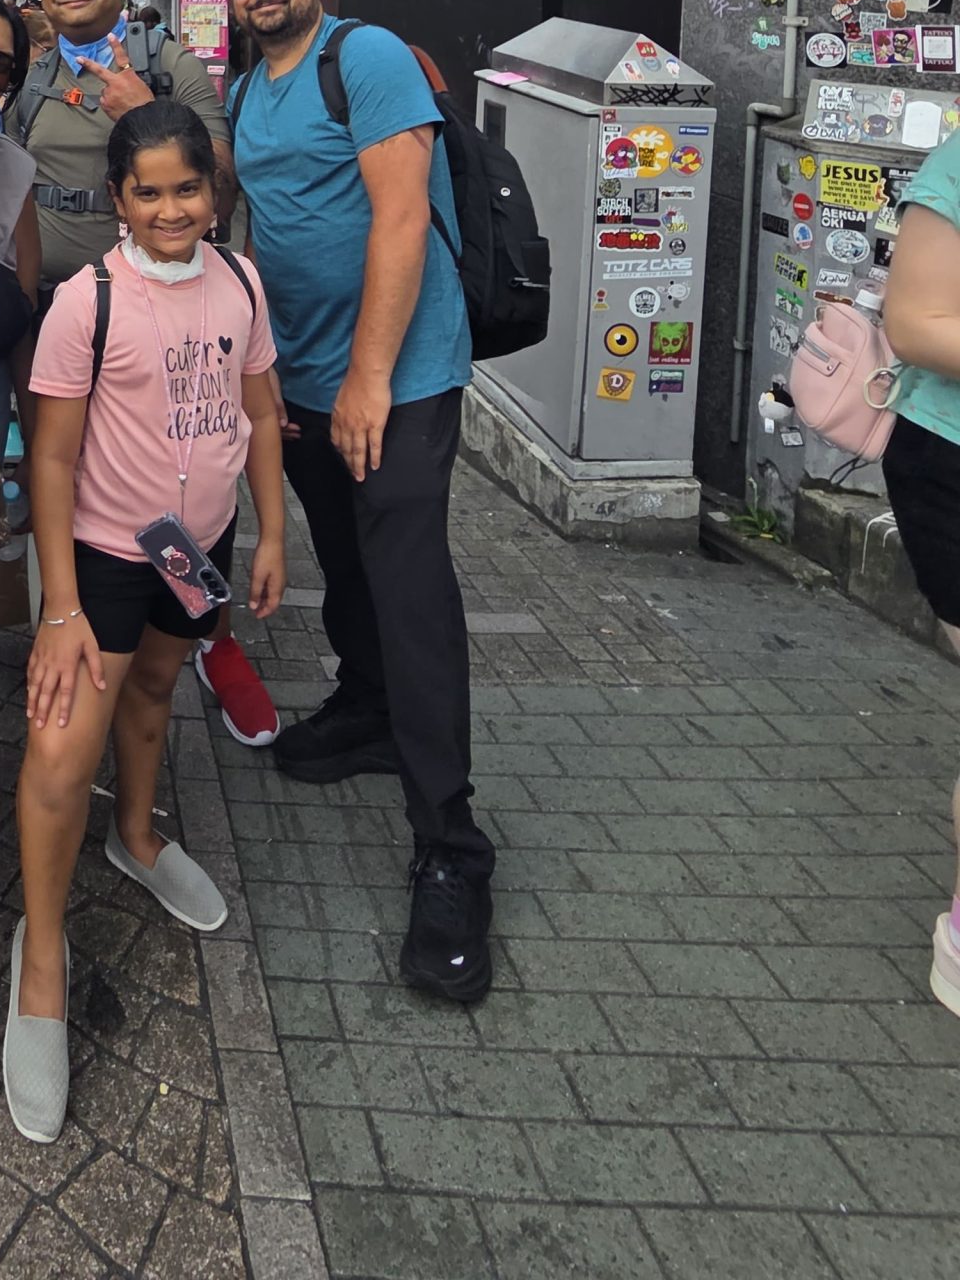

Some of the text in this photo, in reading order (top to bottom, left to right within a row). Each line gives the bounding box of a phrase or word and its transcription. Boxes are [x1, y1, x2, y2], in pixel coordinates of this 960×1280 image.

[822, 164, 879, 183] JESUS
[649, 257, 693, 270] CARS
[166, 333, 215, 373] cuter
[169, 370, 222, 404] VERSON
